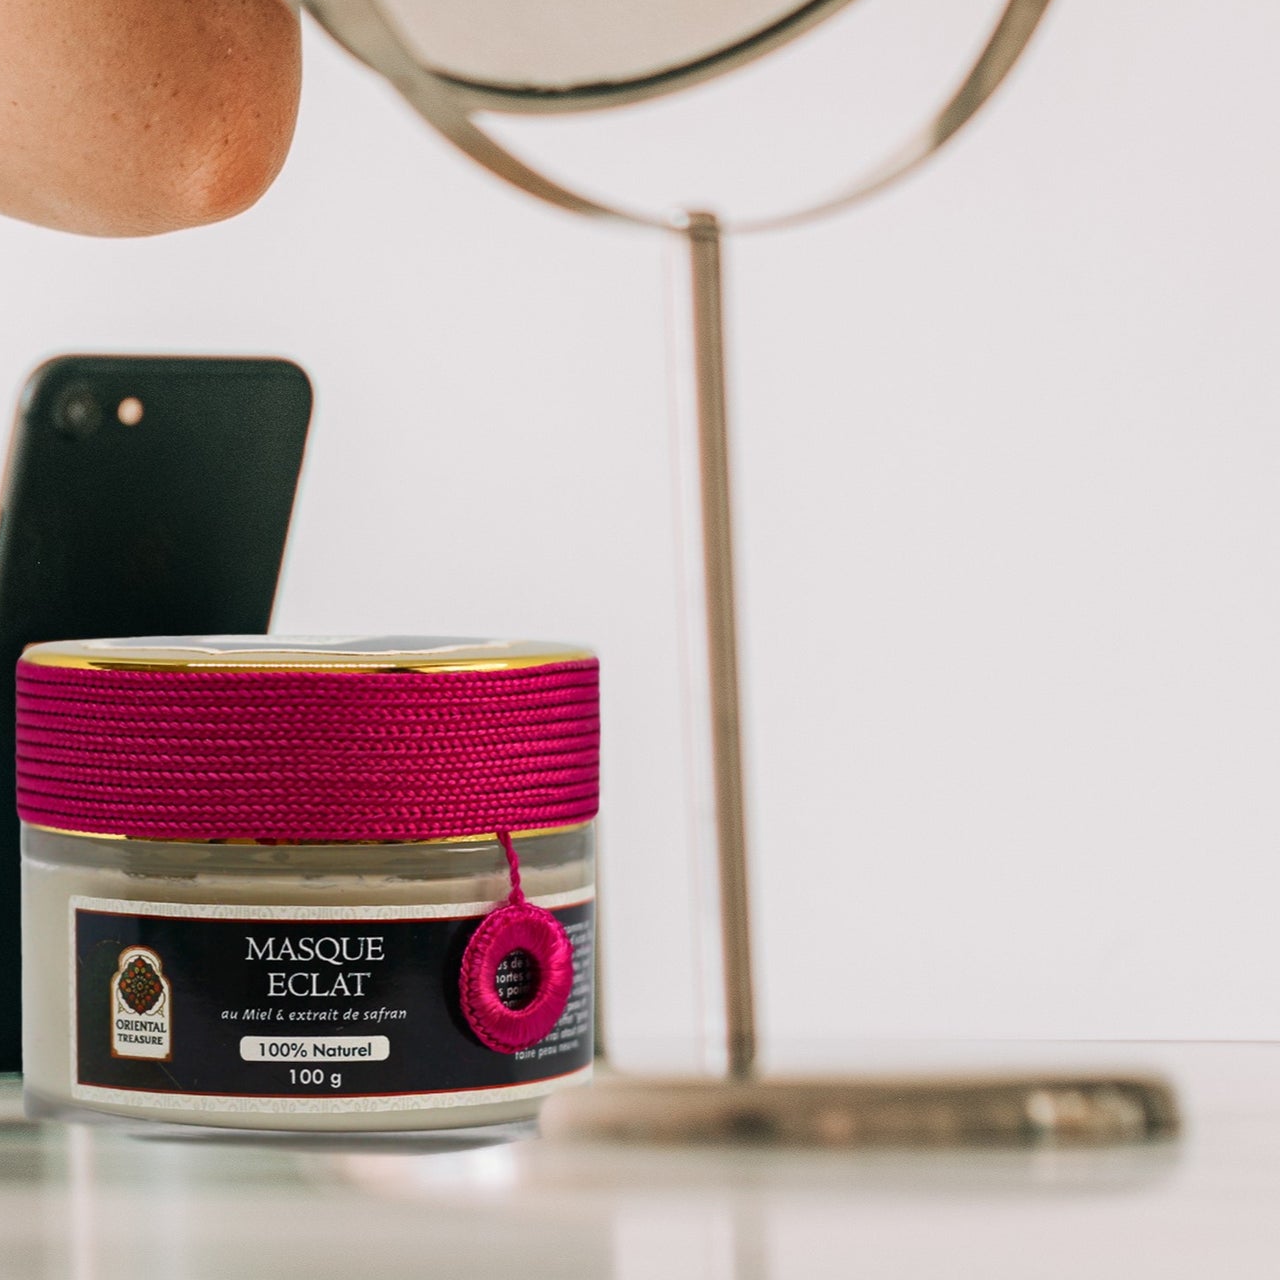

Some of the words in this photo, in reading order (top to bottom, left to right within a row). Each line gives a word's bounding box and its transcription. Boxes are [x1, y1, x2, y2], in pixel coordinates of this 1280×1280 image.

[244, 937, 385, 965] MASQUE
[267, 972, 371, 997] ECLAT
[220, 1008, 238, 1020] au
[242, 1007, 272, 1021] Miel
[276, 1009, 284, 1021] &
[289, 1007, 338, 1021] extrait
[342, 1007, 360, 1021] de
[362, 1007, 407, 1023] safran
[116, 1019, 167, 1033] ORIENTAL
[117, 1033, 163, 1045] TREASURE
[258, 1042, 307, 1058] 100%
[312, 1042, 372, 1058] Naturel
[289, 1068, 324, 1085] 100
[329, 1072, 342, 1088] g
